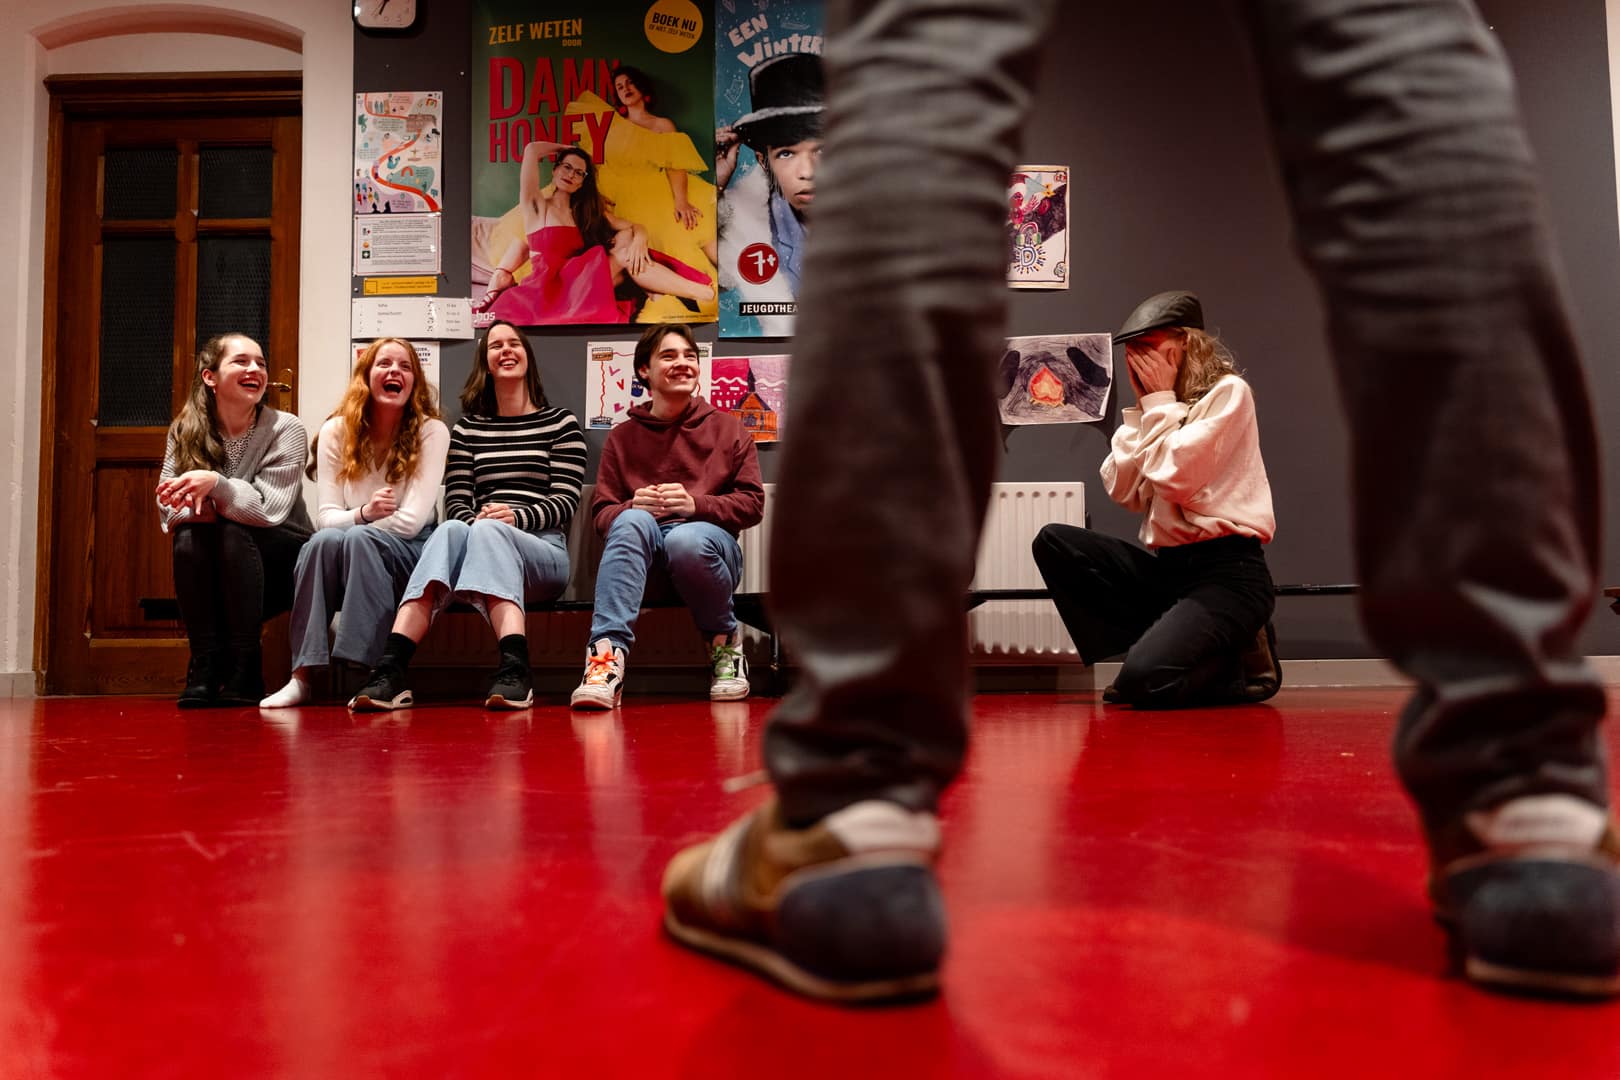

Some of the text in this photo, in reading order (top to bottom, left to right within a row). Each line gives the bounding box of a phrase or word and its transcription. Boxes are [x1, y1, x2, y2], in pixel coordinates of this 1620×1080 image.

[489, 18, 582, 46] ZELF WETEN
[652, 12, 697, 32] BOEK NU
[728, 13, 768, 47] EEN
[489, 56, 621, 120] DAMN
[489, 111, 615, 165] HONEY
[746, 250, 776, 277] 7+
